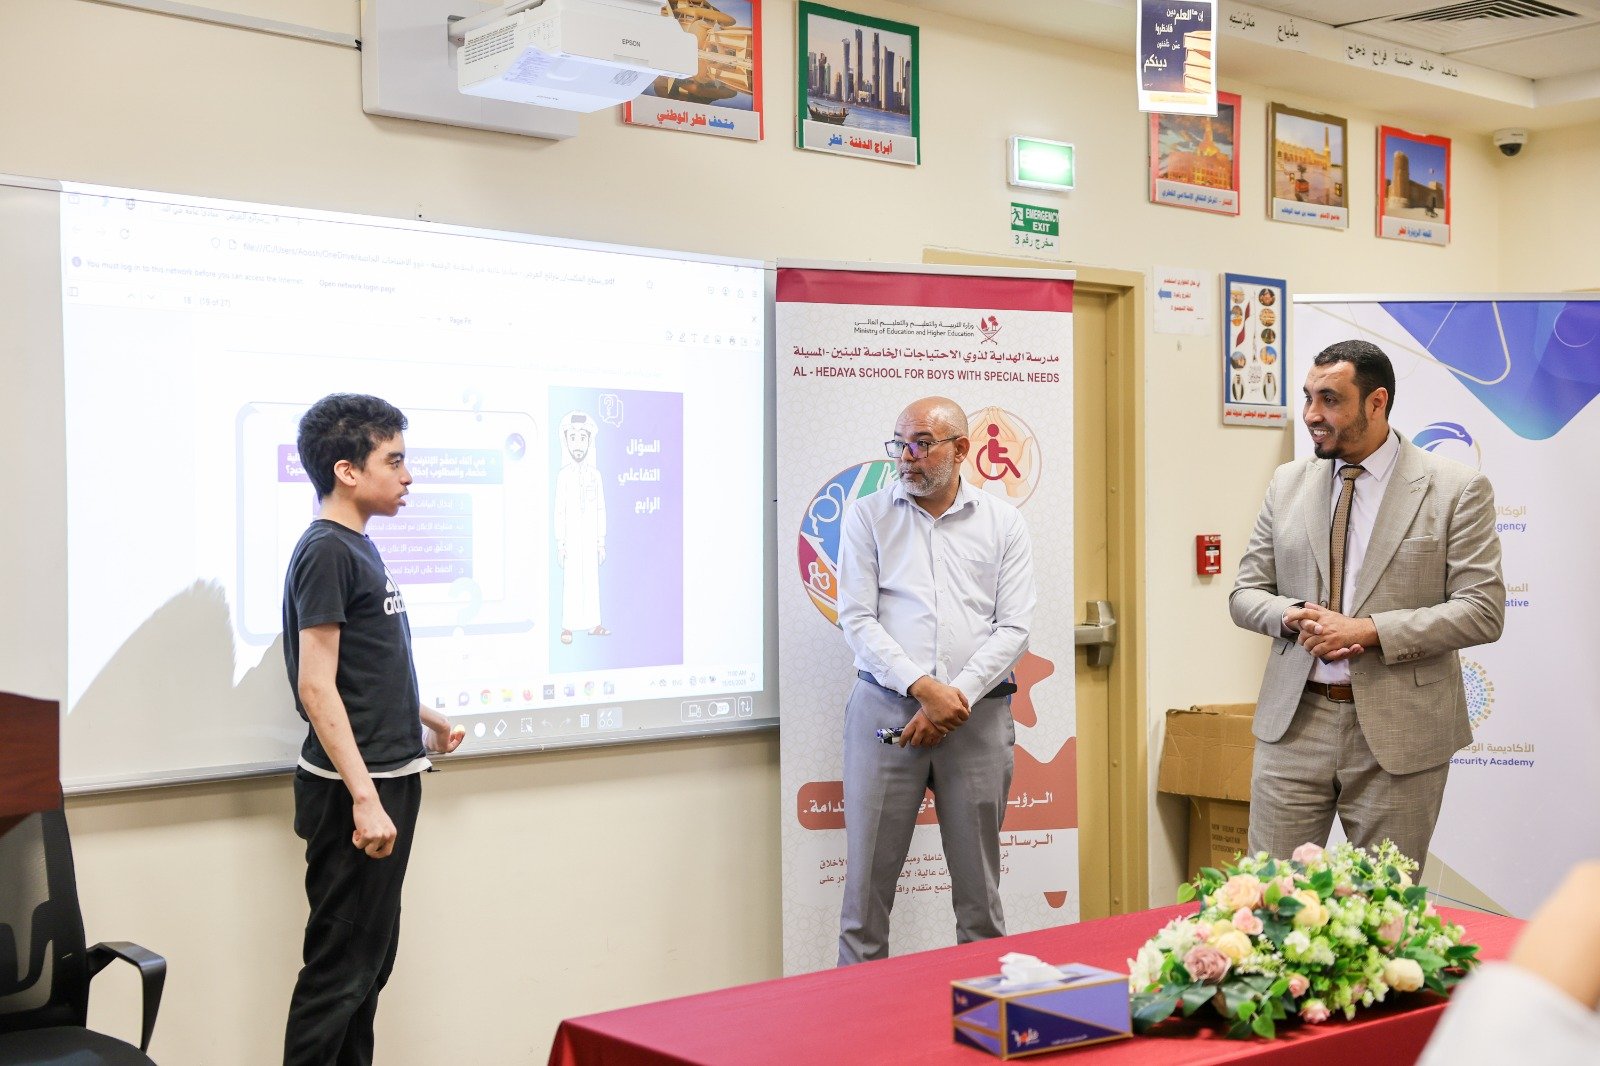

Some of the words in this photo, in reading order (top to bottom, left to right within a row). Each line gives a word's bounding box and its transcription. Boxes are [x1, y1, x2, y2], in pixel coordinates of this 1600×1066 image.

[1174, 9, 1192, 25] العلم
[1155, 23, 1173, 35] فانظروا
[621, 38, 641, 48] EPSON
[1144, 54, 1168, 73] دينكم
[656, 109, 689, 125] الوطني
[690, 112, 707, 127] قطر
[708, 115, 735, 130] متحف
[828, 134, 843, 146] قطر
[849, 136, 873, 151] الدفنة
[874, 140, 893, 155] أبراج
[1025, 208, 1059, 223] EMERGENCY
[1032, 221, 1051, 233] EXIT
[1014, 234, 1020, 245] 3
[1022, 233, 1033, 247] رقم
[1035, 237, 1054, 250] مخرج
[853, 327, 878, 336] Ministry
[879, 327, 886, 335] of
[886, 328, 915, 336] Education
[927, 329, 946, 338] Higher
[947, 330, 975, 338] Education
[963, 322, 975, 330] وزارة
[863, 346, 902, 359] الخاصة
[903, 347, 961, 362] الاحتياجات
[962, 350, 988, 364] لذوي
[990, 350, 1025, 364] الهداية
[1027, 351, 1059, 365] مدرسة
[793, 366, 808, 377] AL
[815, 366, 857, 378] HEDAYA
[858, 367, 902, 379] SCHOOL
[904, 368, 925, 379] FOR
[927, 369, 955, 380] BOYS
[957, 370, 982, 381] WITH
[984, 371, 1025, 382] SPECIAL
[1027, 372, 1060, 383] NEEDS
[626, 438, 661, 457] السؤال
[617, 467, 661, 487] التفاعلي
[634, 496, 661, 515] الرابع
[1495, 522, 1527, 533] gency
[1507, 583, 1529, 595] المبا
[1504, 598, 1530, 607] ative
[1486, 741, 1535, 755] الأكاديمية
[1449, 756, 1488, 767] Security
[1489, 757, 1535, 768] Academy
[1006, 791, 1053, 808] الرؤي
[1000, 832, 1053, 849] الرسال
[905, 855, 921, 865] ومبت
[924, 853, 943, 862] شاملة
[819, 875, 835, 885] على
